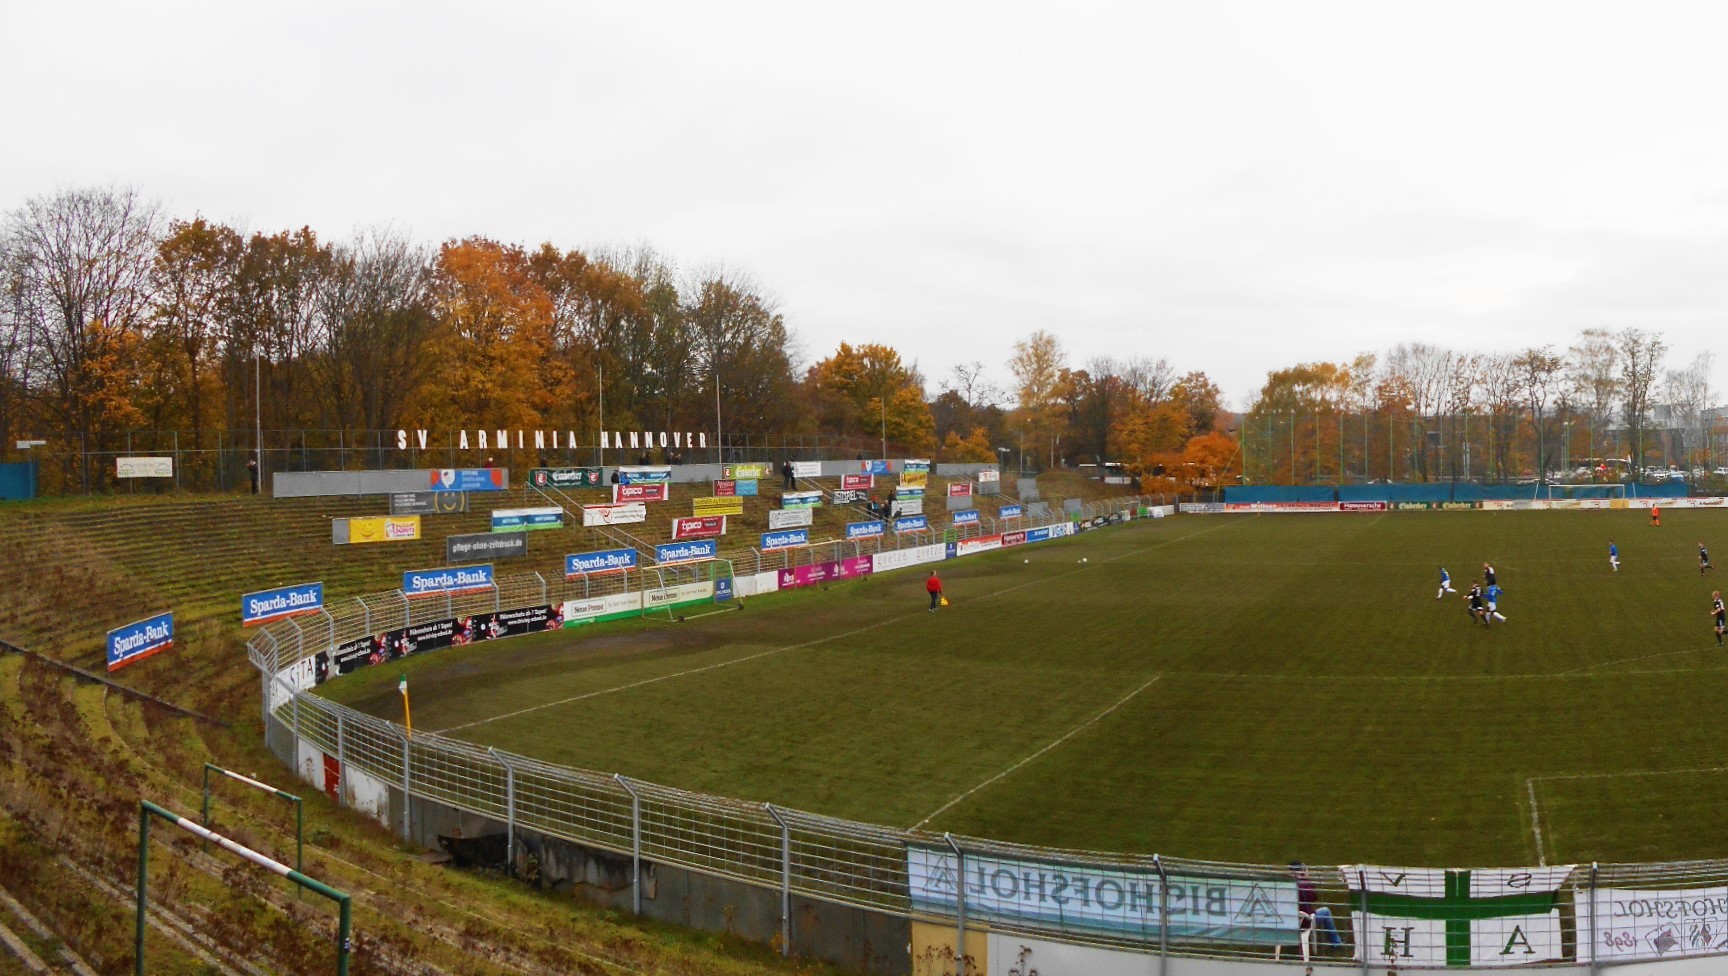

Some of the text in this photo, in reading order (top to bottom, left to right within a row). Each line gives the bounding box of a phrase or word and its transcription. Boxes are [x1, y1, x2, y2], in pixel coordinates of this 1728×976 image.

[397, 430, 707, 450] SV ARMINIA HANNOVER
[622, 485, 643, 497] tipico
[849, 523, 882, 536] Sparda-Bank
[765, 533, 806, 548] Sparda-Bank
[660, 544, 711, 562] Sparda-Bank
[571, 553, 631, 572] Sparda-Bank
[413, 570, 487, 592] Sparda-Bank
[250, 589, 317, 616] Sparda-Bank
[574, 606, 587, 614] Neue
[113, 620, 169, 658] Sparda-Bank
